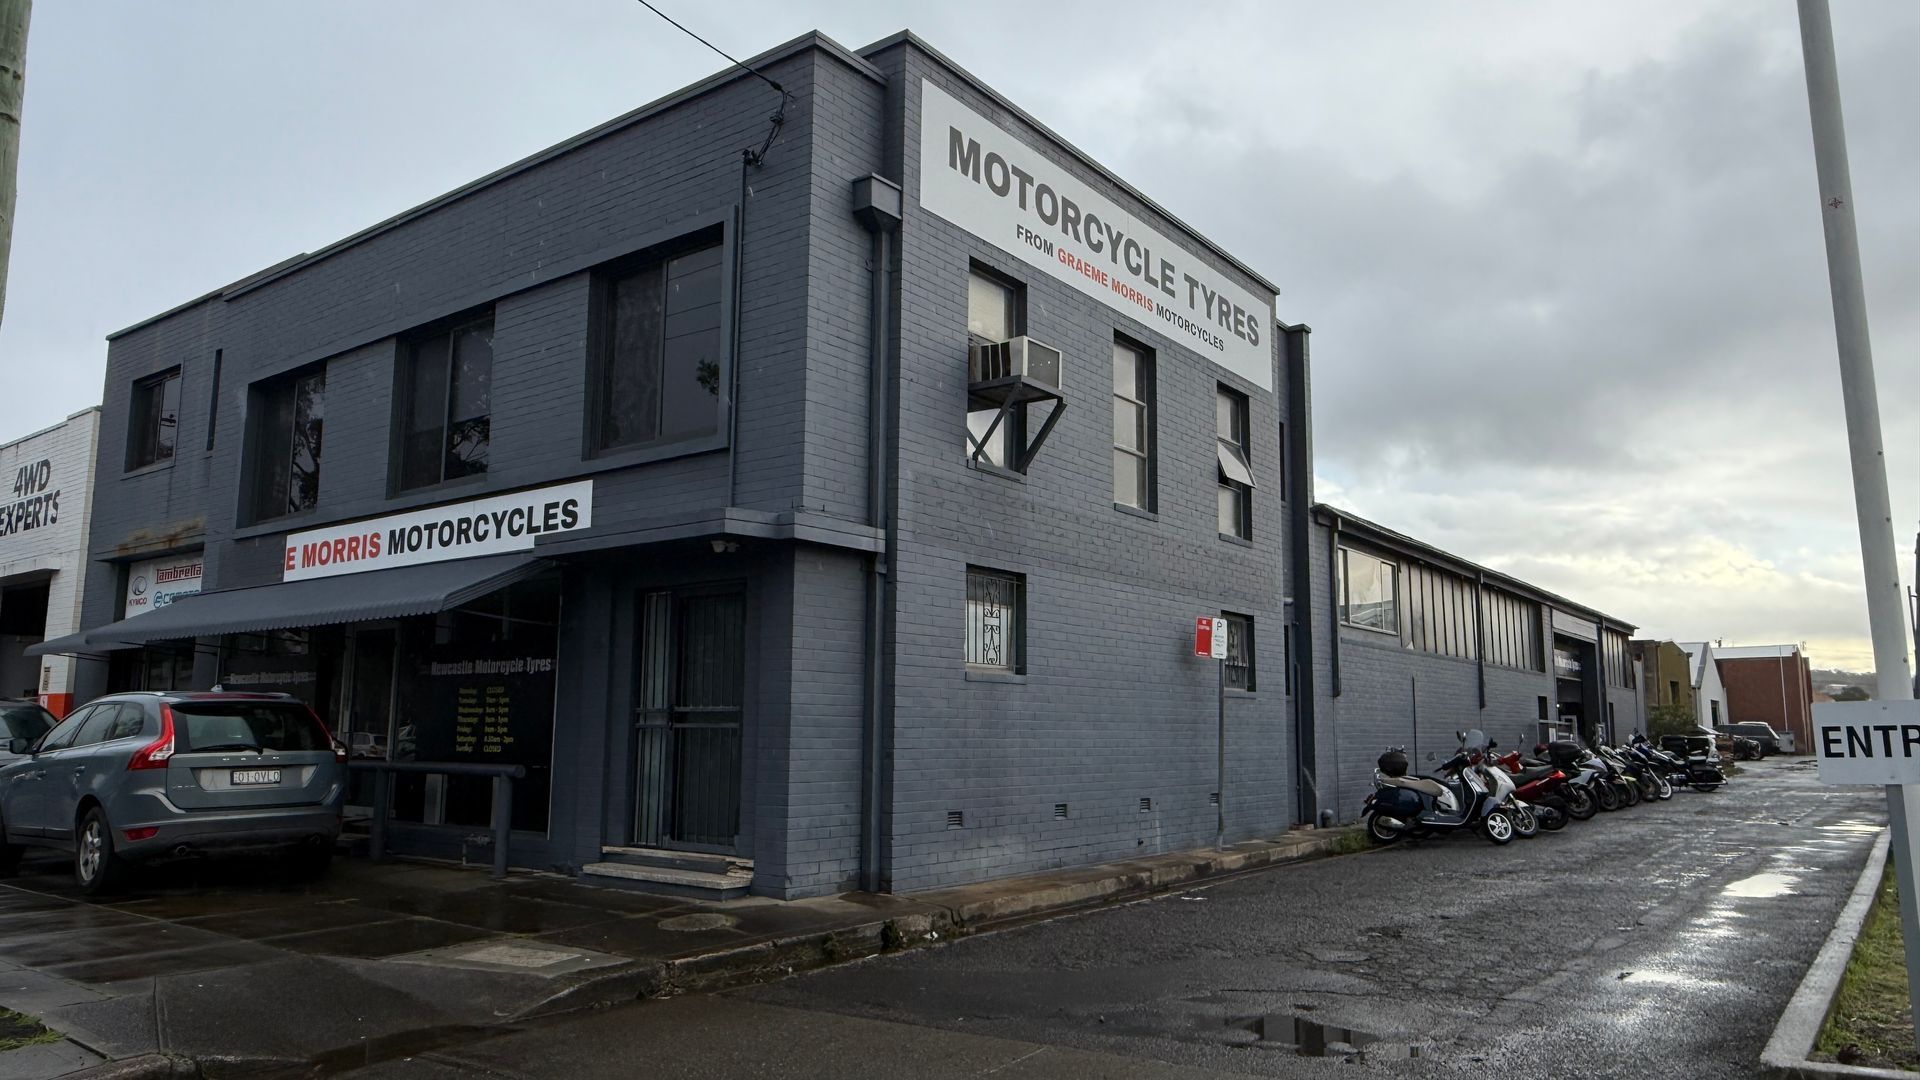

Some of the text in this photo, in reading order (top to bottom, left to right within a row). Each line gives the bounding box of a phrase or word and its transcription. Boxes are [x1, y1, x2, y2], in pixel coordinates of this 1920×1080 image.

[949, 125, 1260, 347] MOTORCYCLE TYRES
[1016, 223, 1225, 352] FROM GRAEME MORRIS MOTORCYCLES
[13, 459, 51, 498] 4WD
[0, 490, 60, 537] EXPERTS
[286, 499, 579, 571] E MORRIS MOTORCYCLES
[431, 656, 551, 675] Newcastle Motorcycle Tyres
[1821, 724, 1920, 758] ENTR
